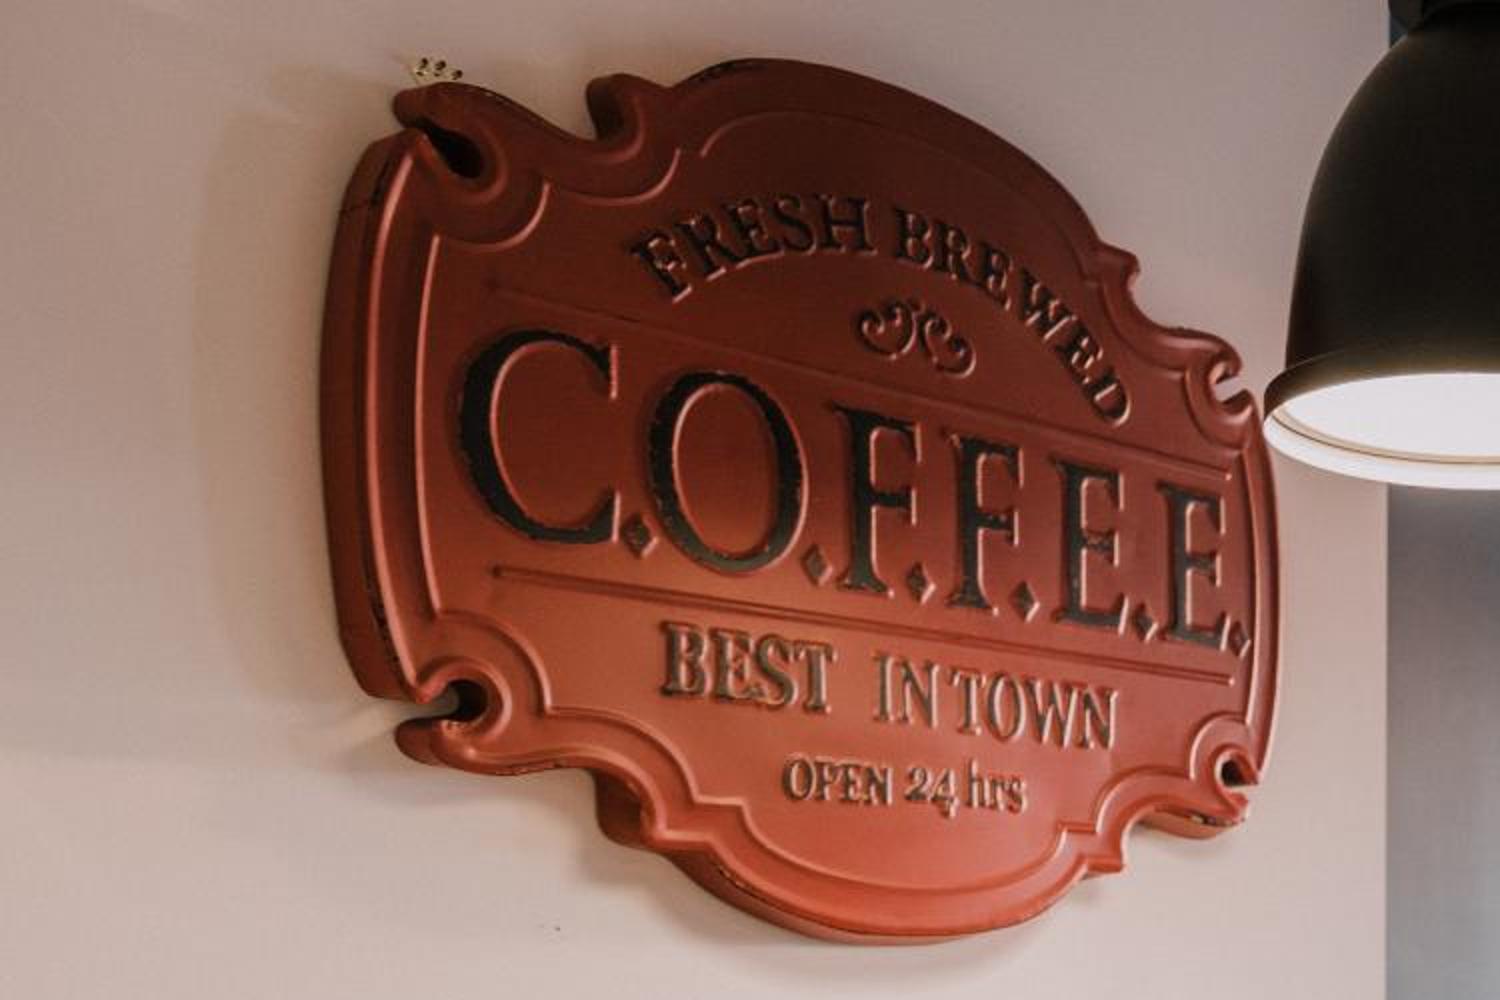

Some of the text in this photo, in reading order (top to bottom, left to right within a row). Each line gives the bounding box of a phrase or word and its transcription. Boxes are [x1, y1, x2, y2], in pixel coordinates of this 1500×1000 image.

[631, 194, 1132, 427] FRESH BREWED
[660, 622, 1119, 751] BEST IN TOWN
[782, 754, 1029, 818] OPEN 24 hrs
